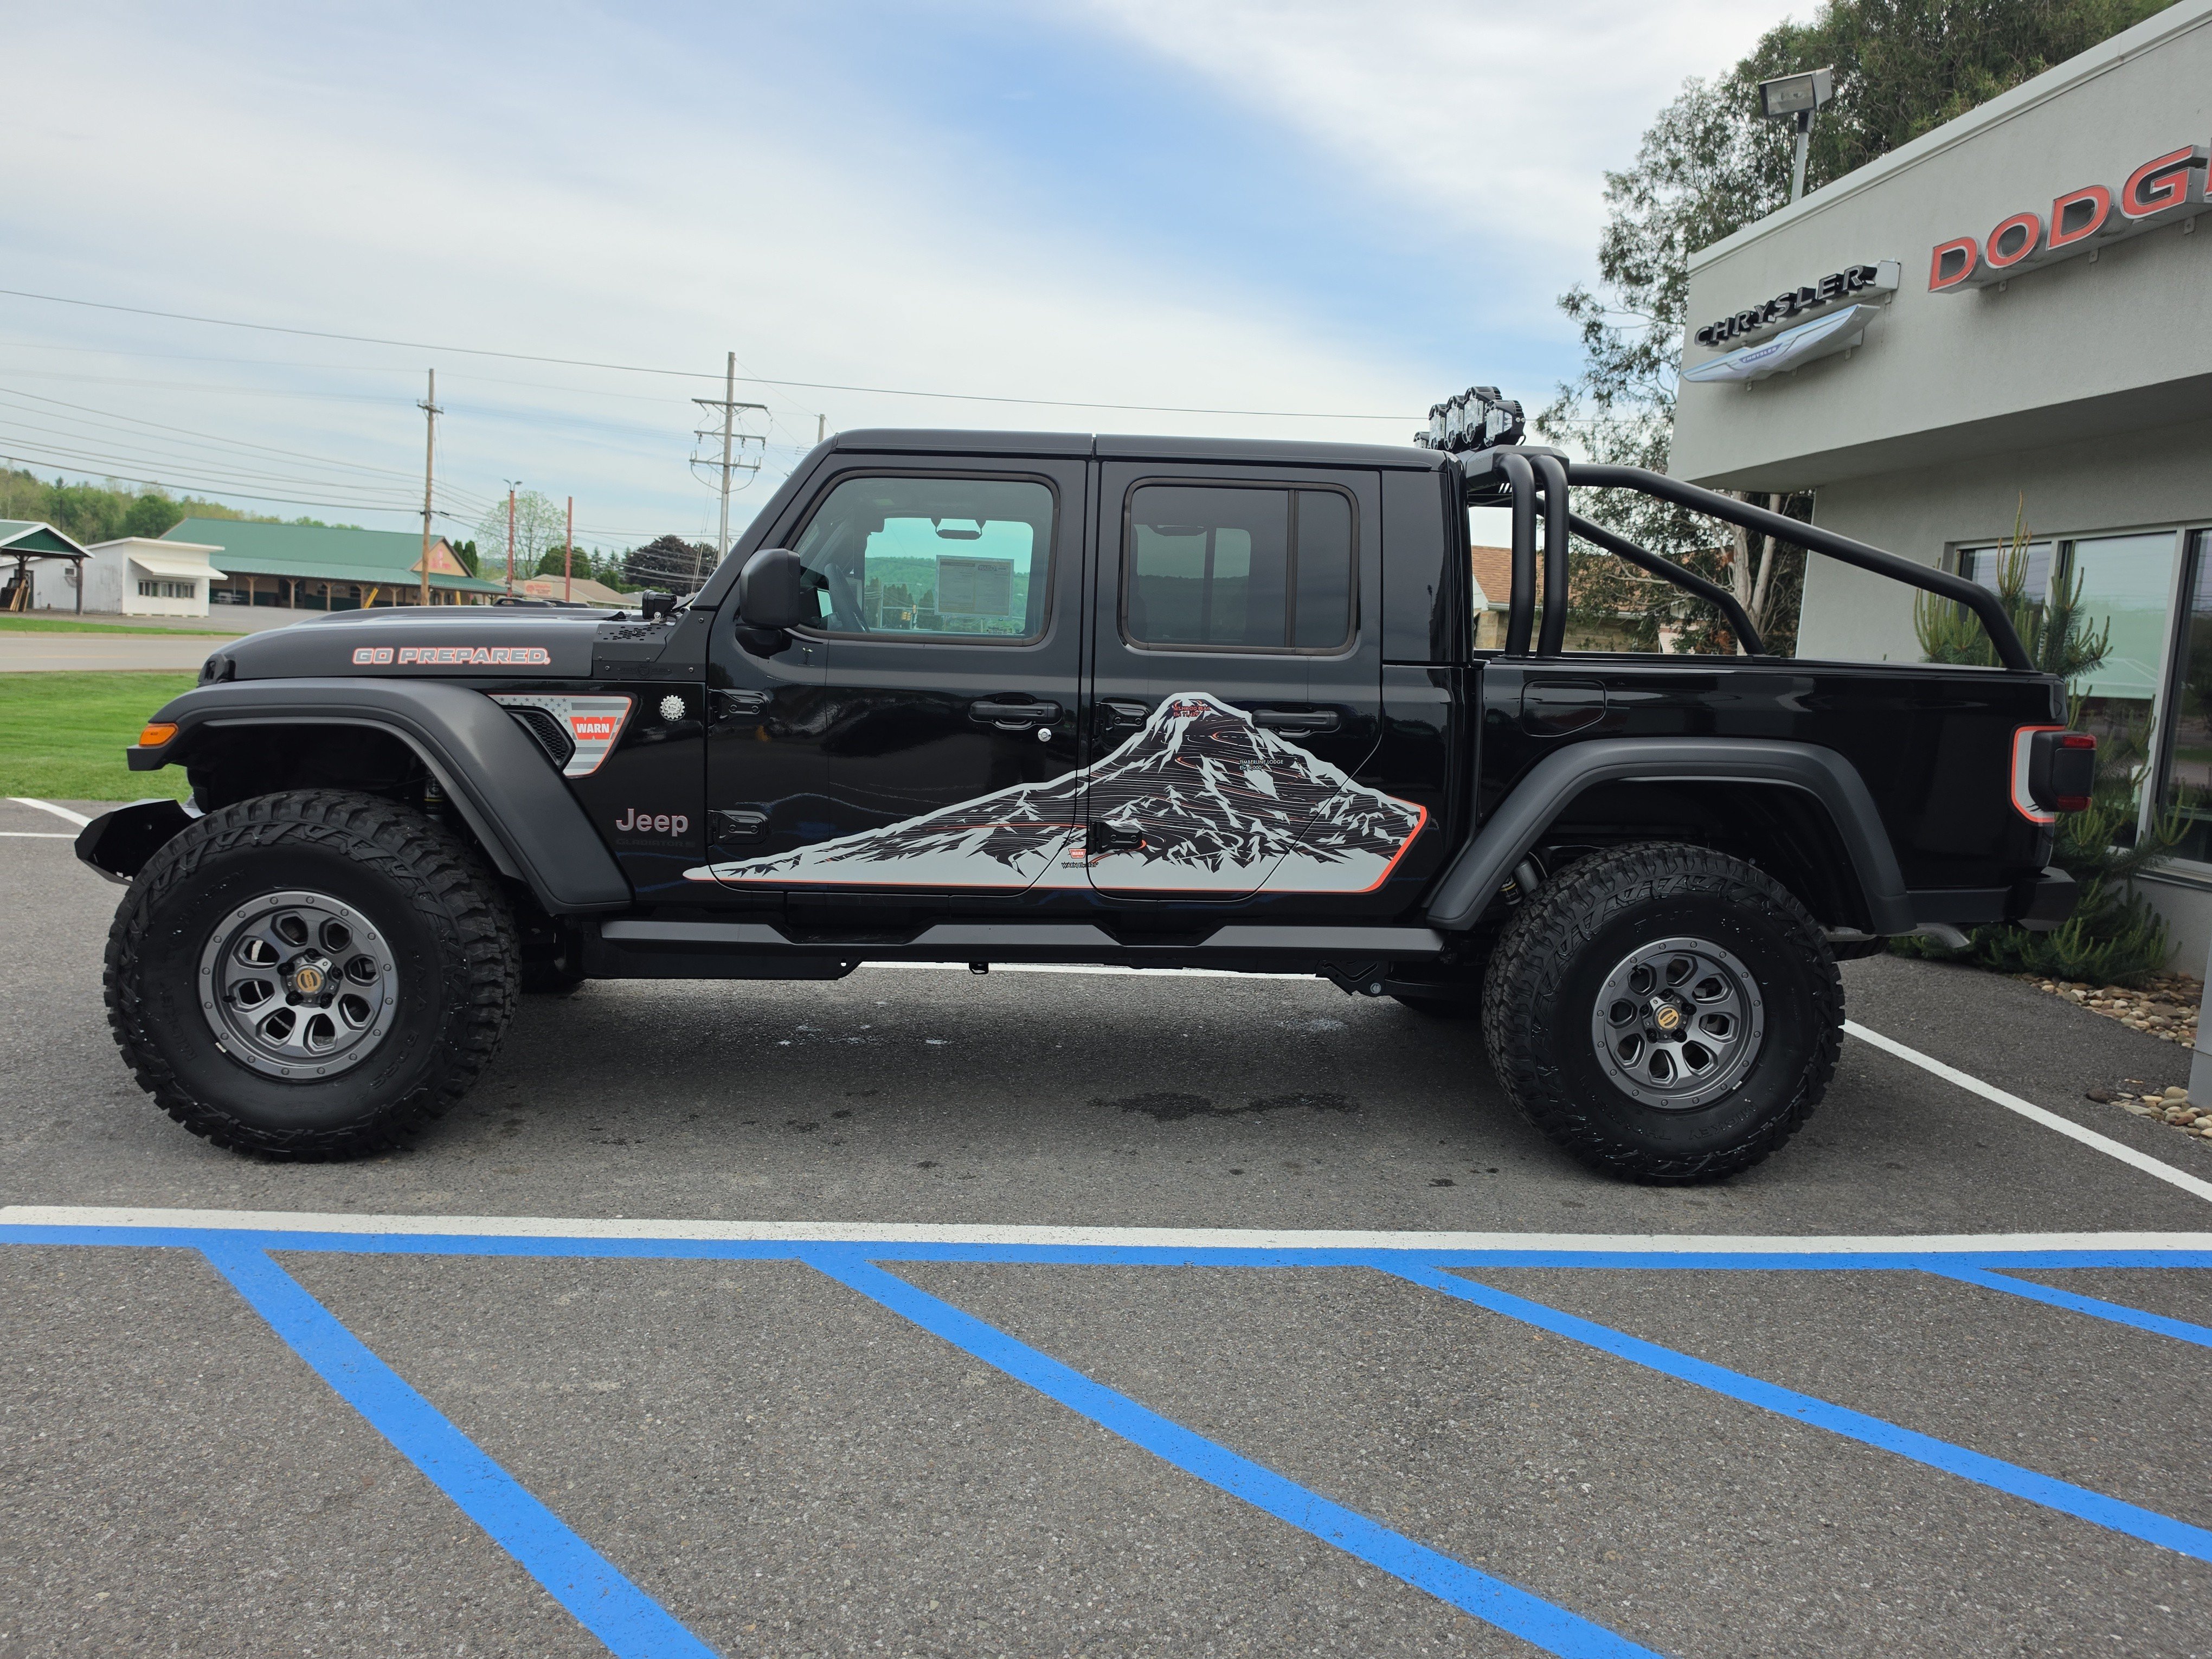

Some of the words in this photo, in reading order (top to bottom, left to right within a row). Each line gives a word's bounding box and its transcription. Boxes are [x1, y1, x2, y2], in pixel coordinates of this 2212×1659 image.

[1928, 138, 2212, 293] DODG
[1694, 265, 1868, 348] CHRYSLER
[353, 647, 395, 665] GO
[397, 647, 551, 665] PREPARED.
[576, 723, 609, 733] WARN
[616, 808, 689, 837] Jeep
[616, 838, 685, 847] GLADIATOR
